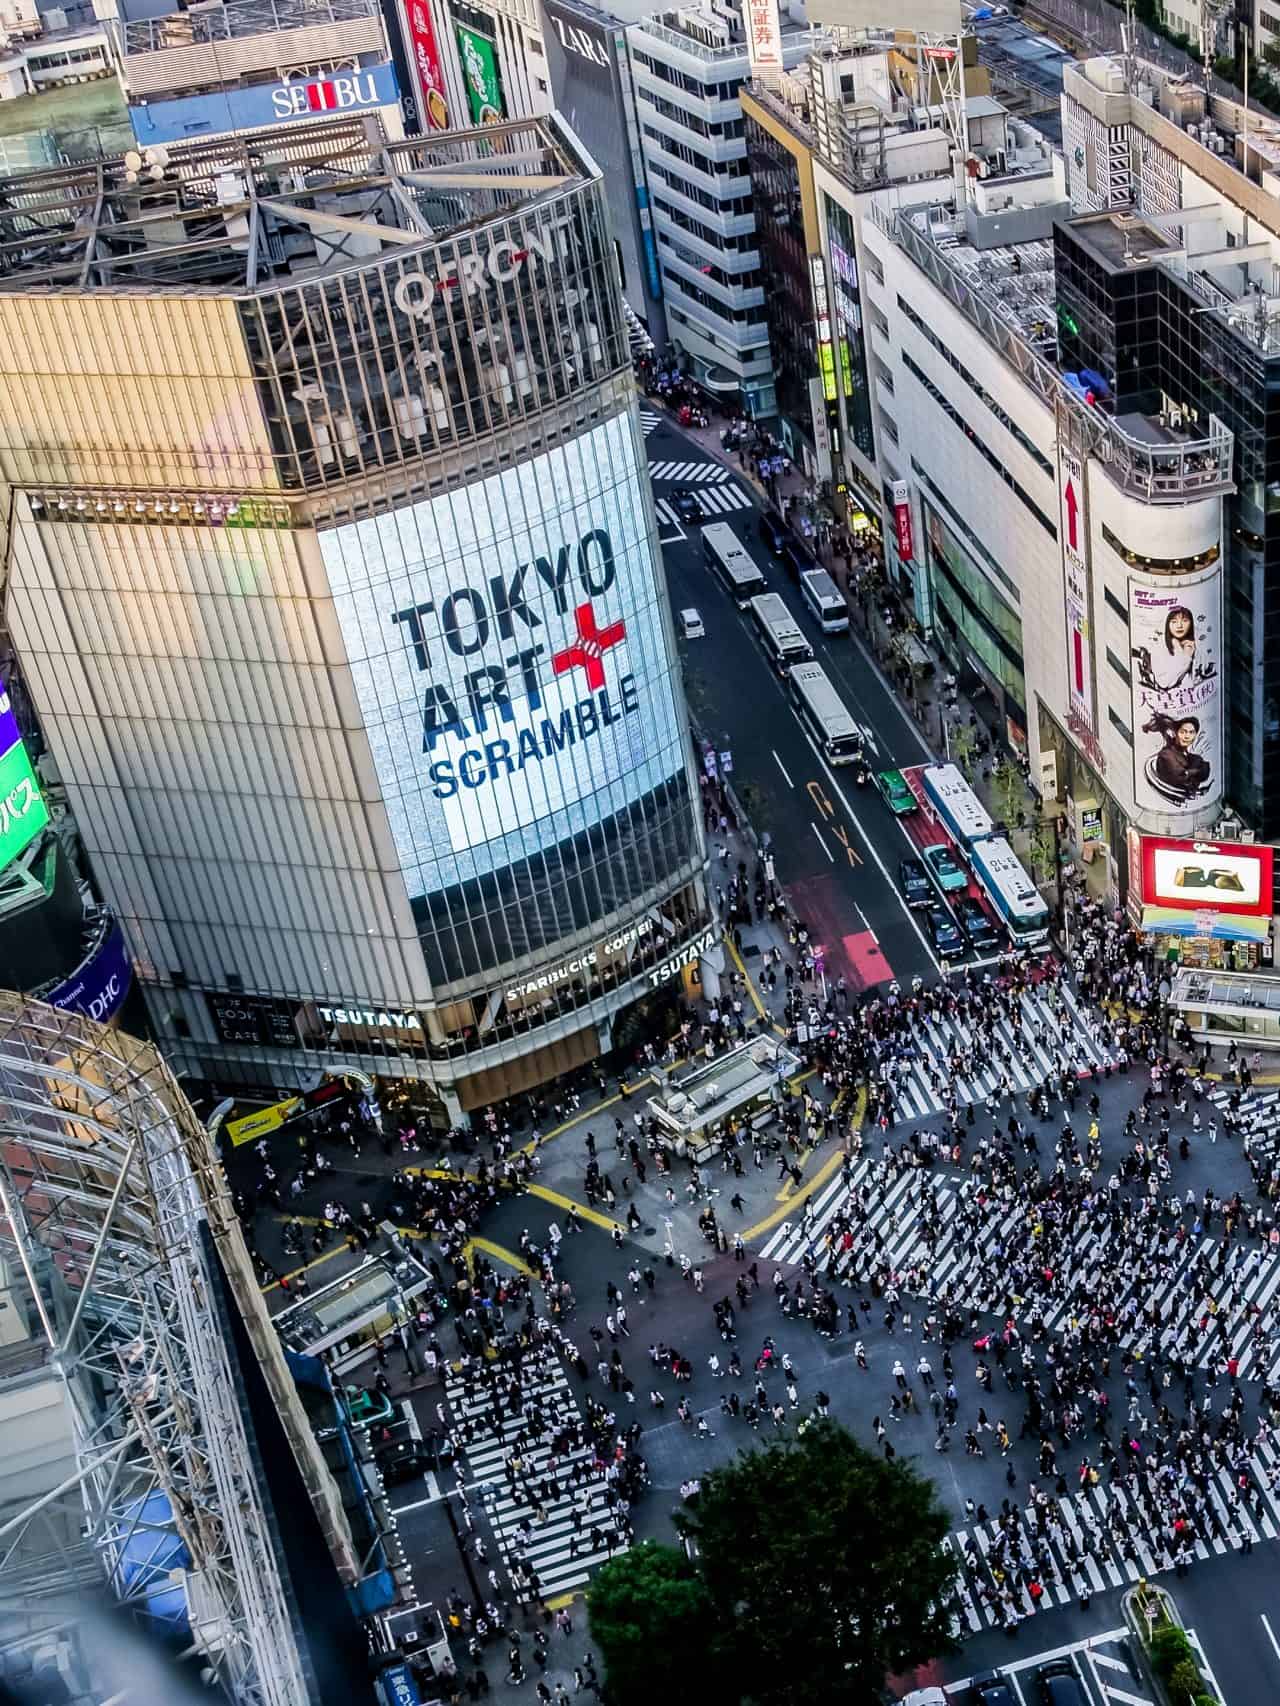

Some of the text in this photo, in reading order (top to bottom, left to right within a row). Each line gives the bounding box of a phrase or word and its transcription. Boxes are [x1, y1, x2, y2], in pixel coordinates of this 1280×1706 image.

[551, 16, 610, 68] ZARA
[271, 74, 380, 118] SEIBU
[391, 528, 615, 671] TOKYO
[422, 643, 544, 754] ART
[428, 673, 640, 799] SCRAMBLE
[506, 951, 598, 1001] STARBUCKS
[649, 932, 716, 988] TSUTAYA
[88, 973, 121, 1020] DHC
[319, 1007, 421, 1029] TSUTAYA
